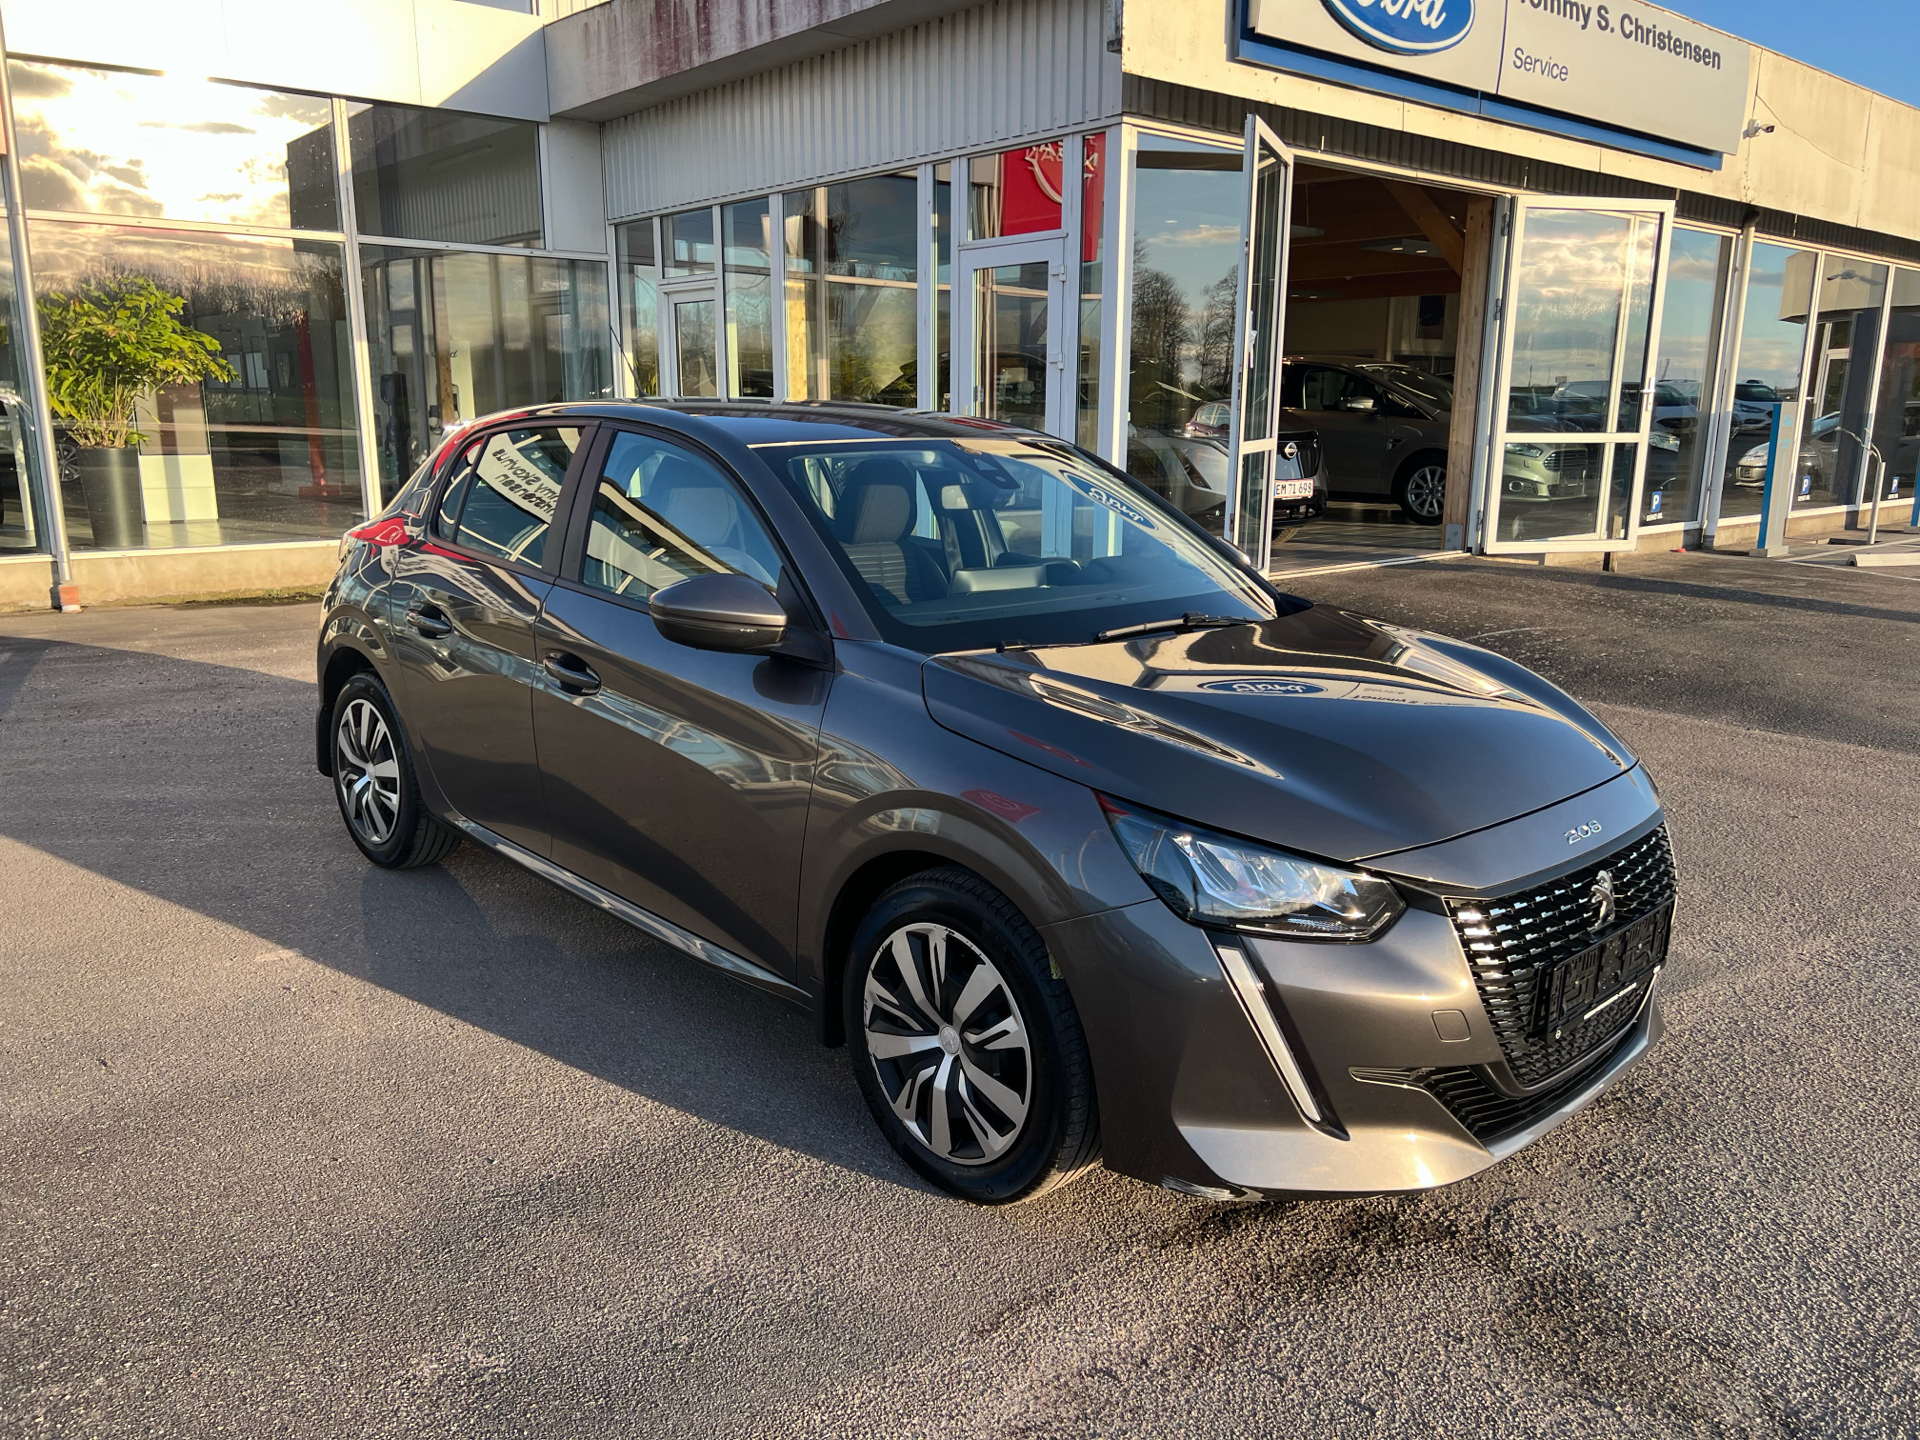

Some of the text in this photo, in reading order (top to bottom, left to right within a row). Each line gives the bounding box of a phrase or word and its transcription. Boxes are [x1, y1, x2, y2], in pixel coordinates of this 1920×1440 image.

[1597, 5, 1615, 33] S.
[1620, 13, 1721, 70] Christensen
[1512, 47, 1568, 82] Service
[1275, 482, 1312, 495] EM 71 698
[1563, 819, 1602, 845] 208
